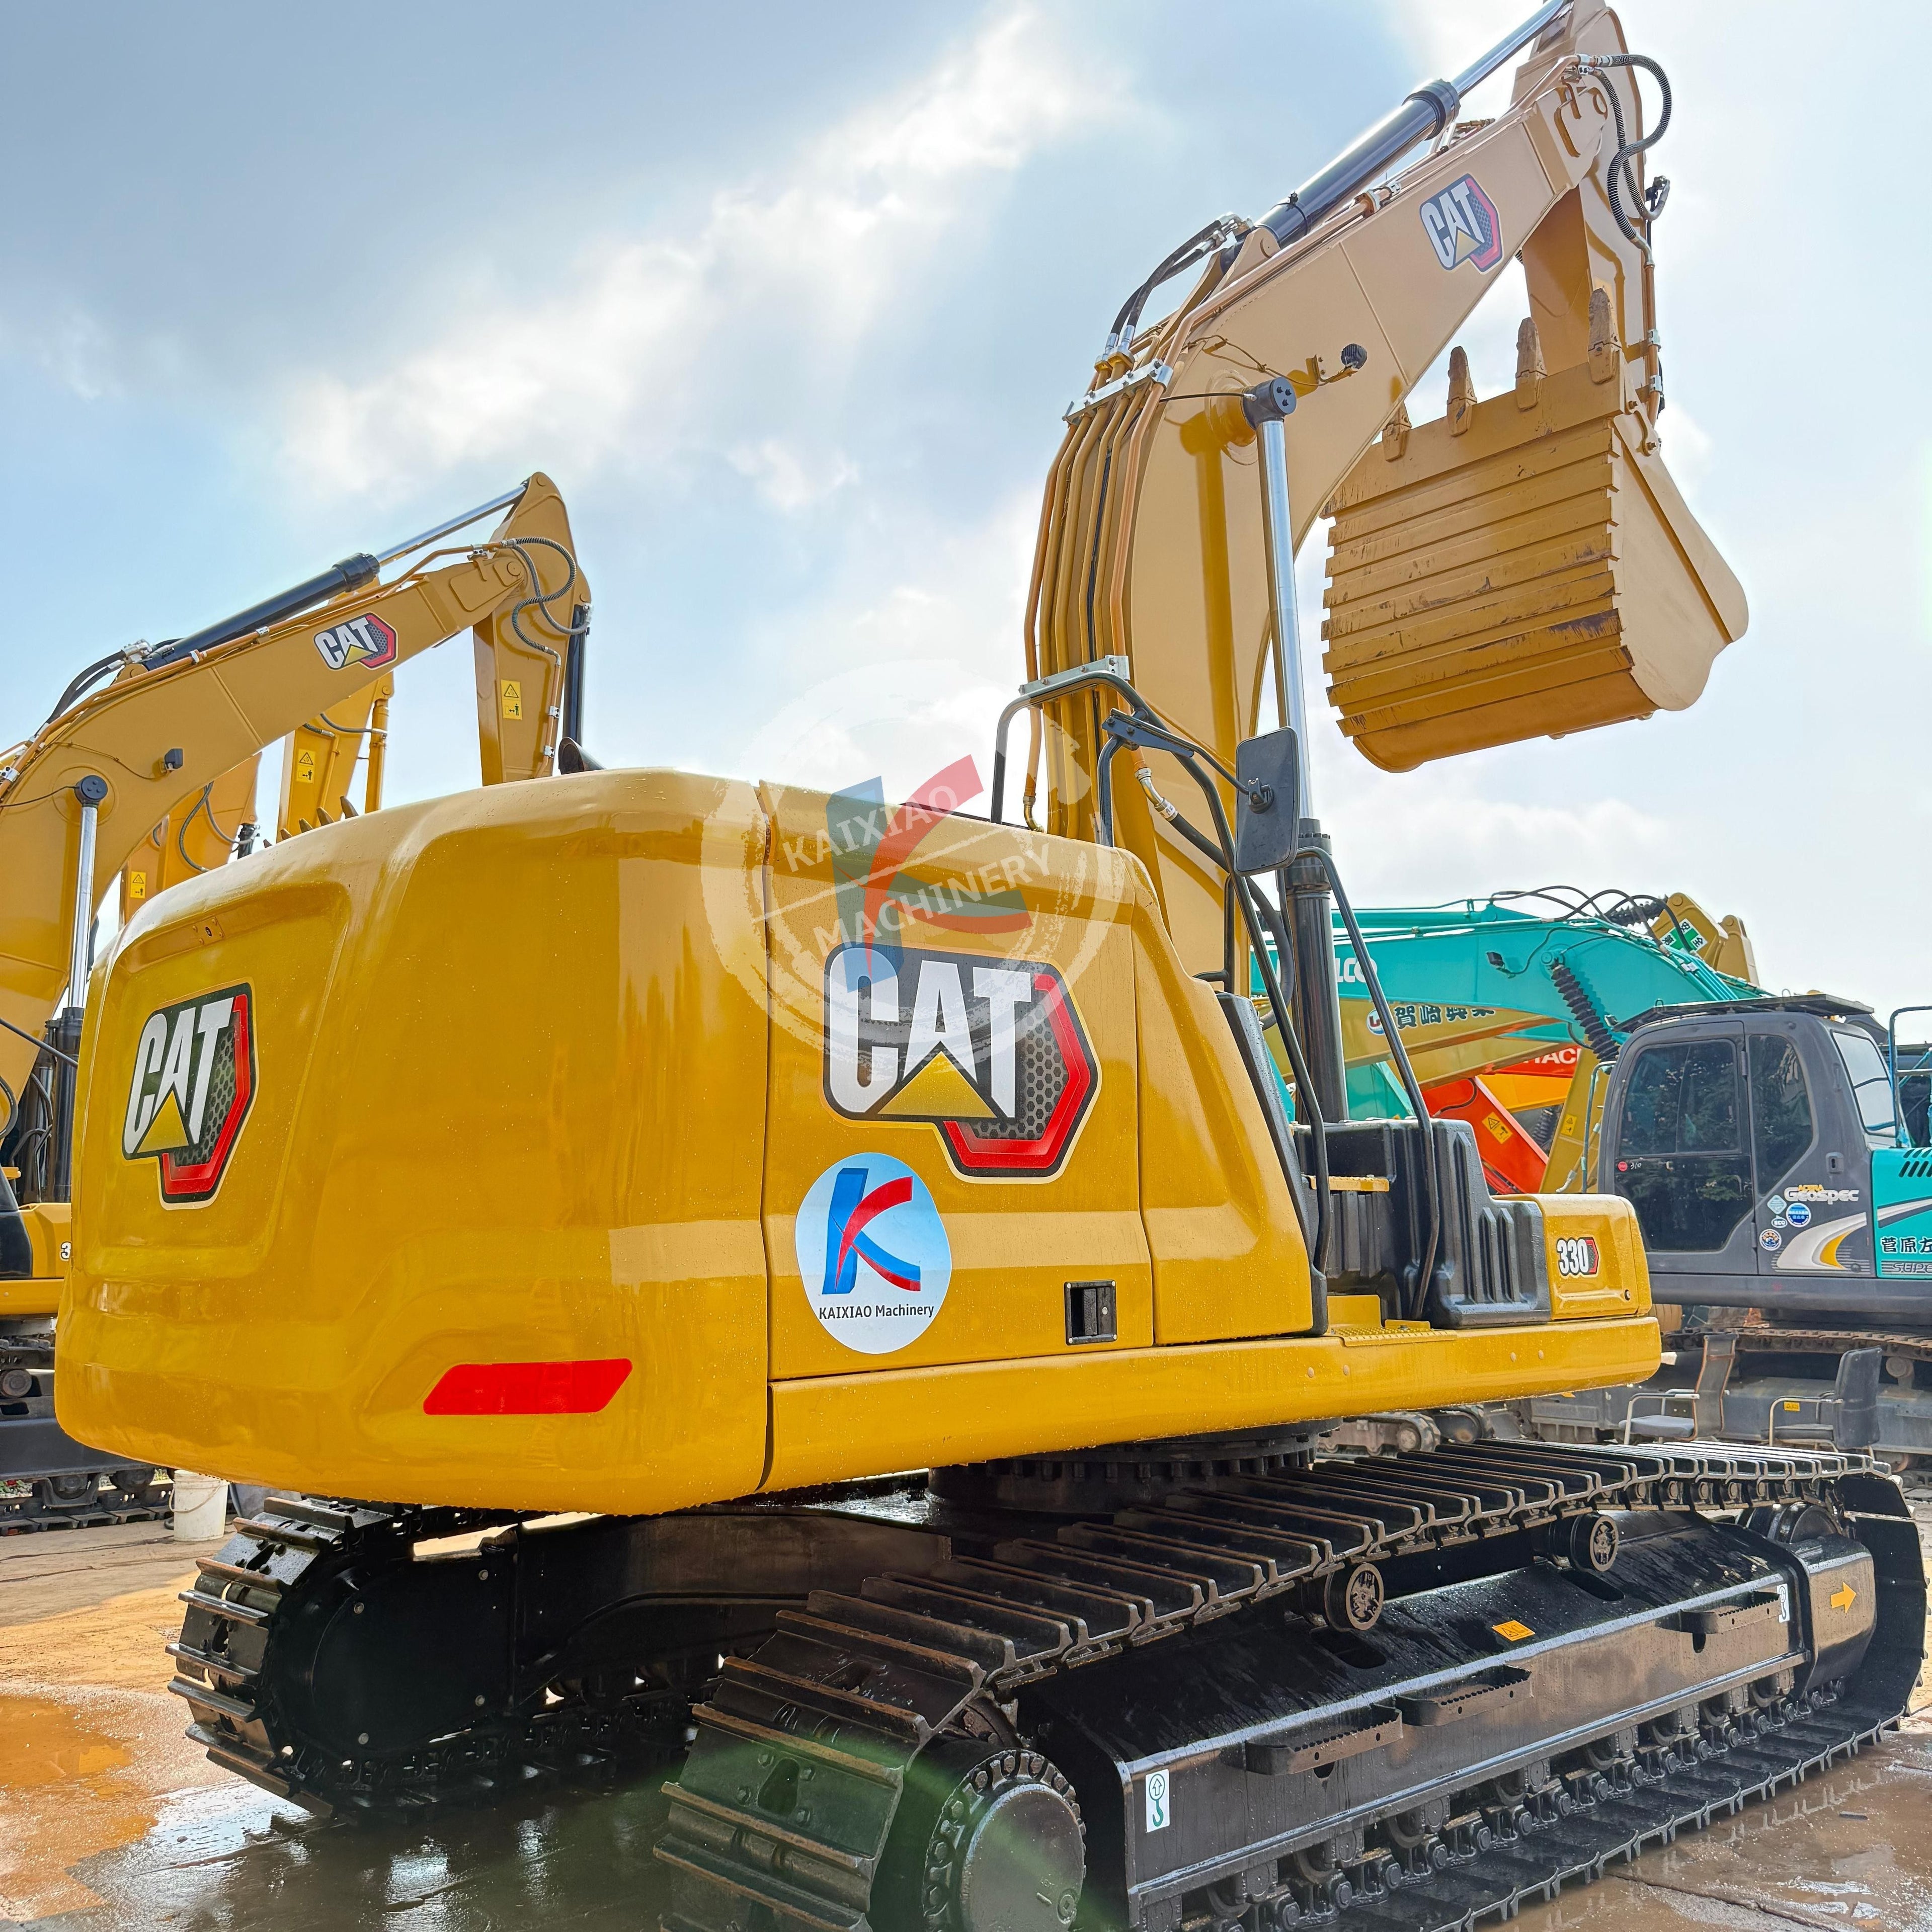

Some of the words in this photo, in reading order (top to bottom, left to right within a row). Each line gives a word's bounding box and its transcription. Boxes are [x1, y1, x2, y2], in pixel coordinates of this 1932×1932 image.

[1421, 181, 1485, 268] CAT
[315, 617, 378, 669] CAT
[829, 947, 1032, 1118] CAT
[124, 997, 234, 1154] CAT
[1557, 1239, 1589, 1274] 330
[819, 1305, 872, 1319] KAIXIAO
[875, 1304, 934, 1318] Machinery
